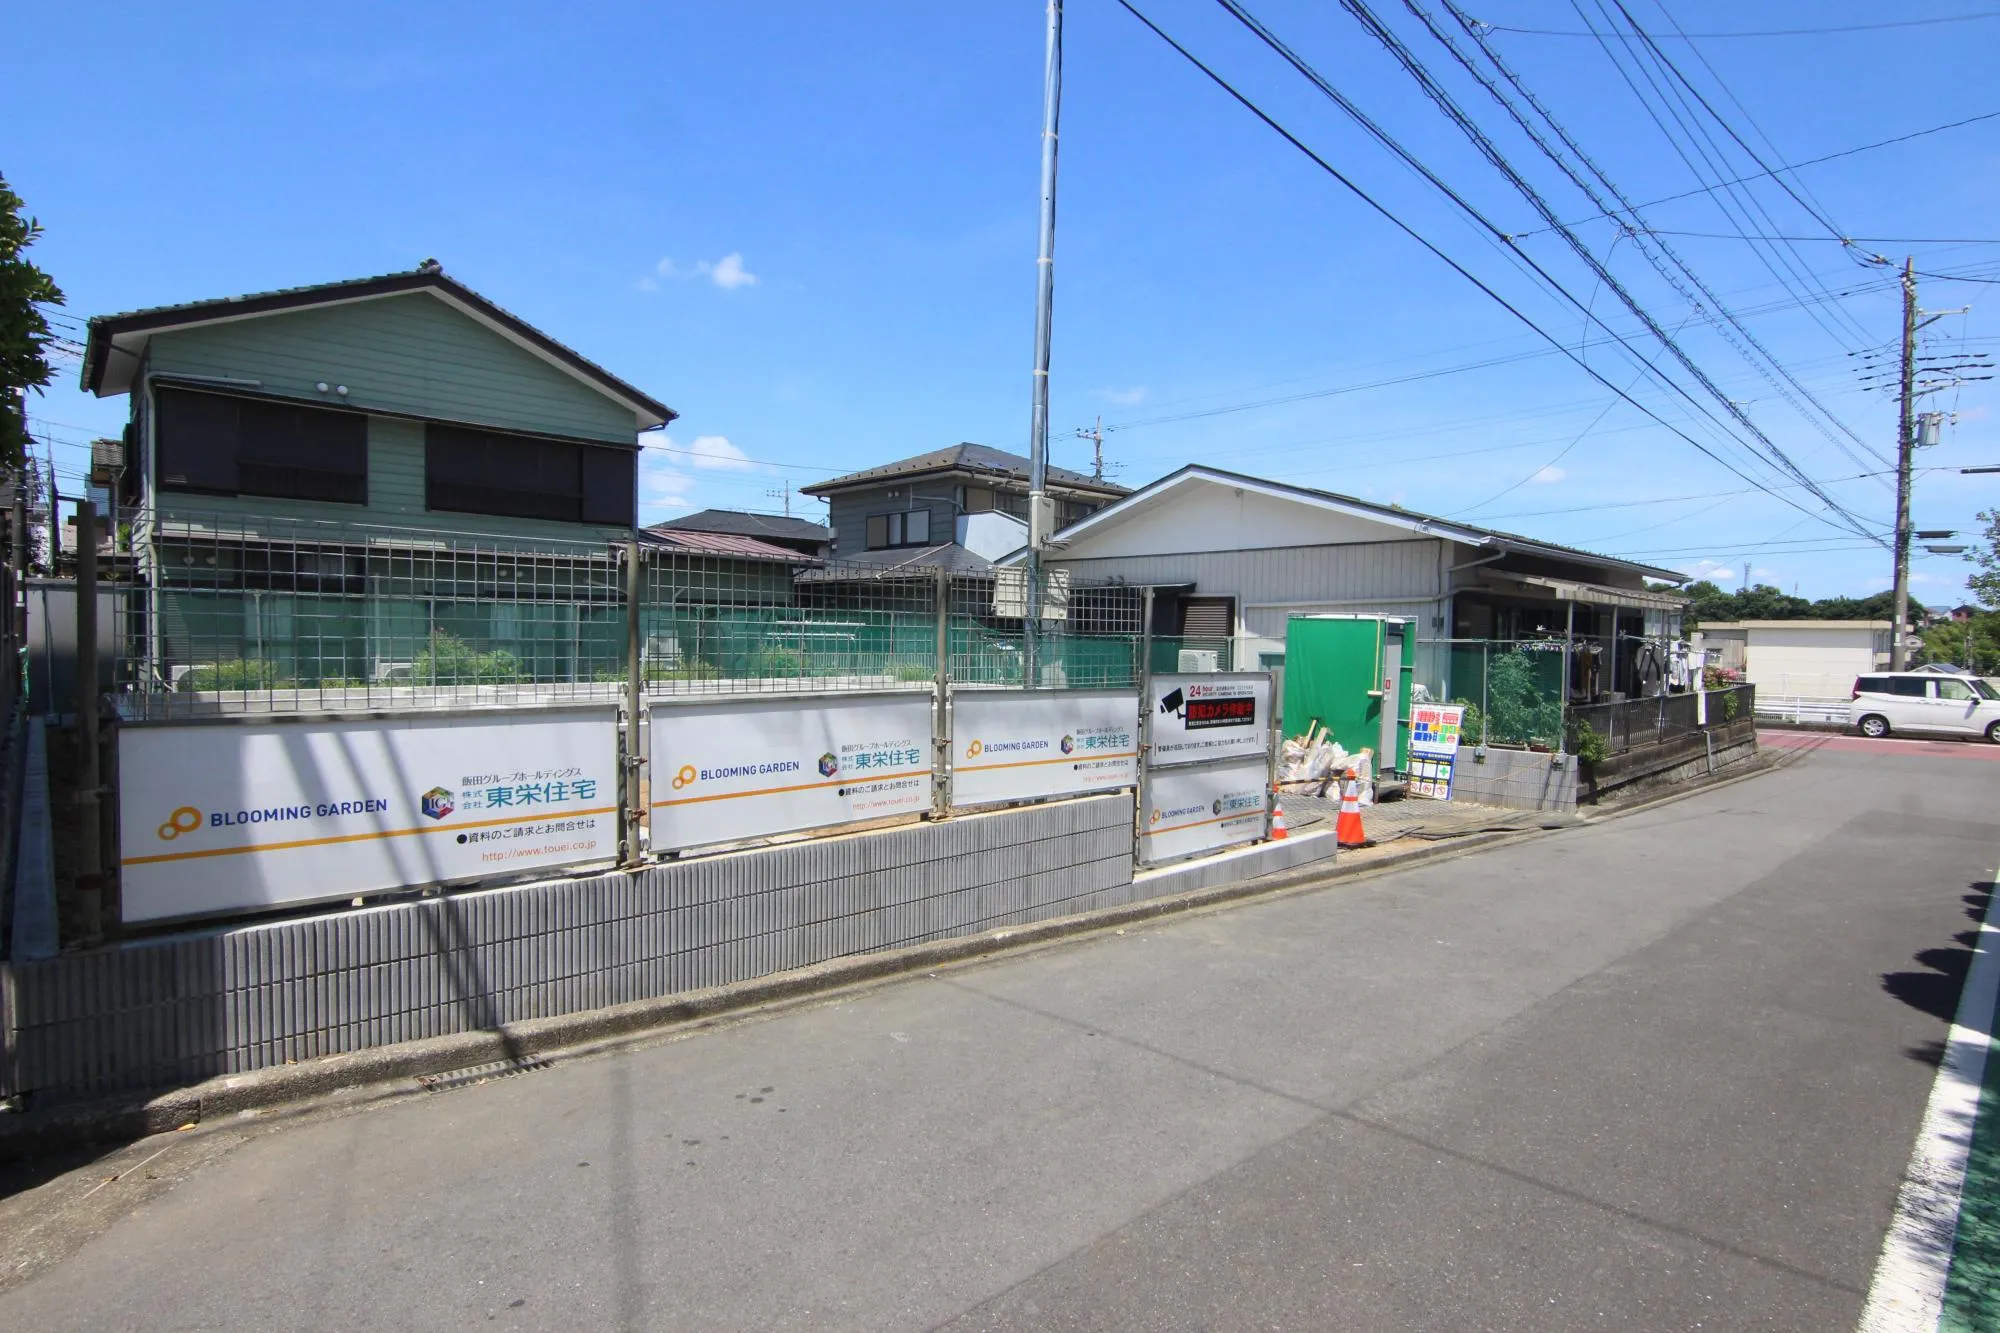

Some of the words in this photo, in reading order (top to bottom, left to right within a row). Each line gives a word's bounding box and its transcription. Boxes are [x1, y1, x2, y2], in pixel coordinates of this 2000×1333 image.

[1189, 685, 1201, 697] 24
[984, 742, 1021, 753] BLOOMING
[1021, 740, 1049, 750] GARDEN
[1085, 734, 1130, 749] 東栄住宅
[855, 748, 920, 770] 東栄住宅
[462, 767, 582, 787] 飯田グループホールディングス
[700, 763, 757, 781] BLOOMING
[759, 760, 800, 776] GARDEN
[485, 779, 597, 809] 東栄住宅
[210, 806, 311, 828] BLOOMING
[316, 799, 388, 818] GARDEN
[468, 819, 596, 843] 資料のご請求とお問合せは
[482, 839, 597, 862] http://www.touei.co.jp
